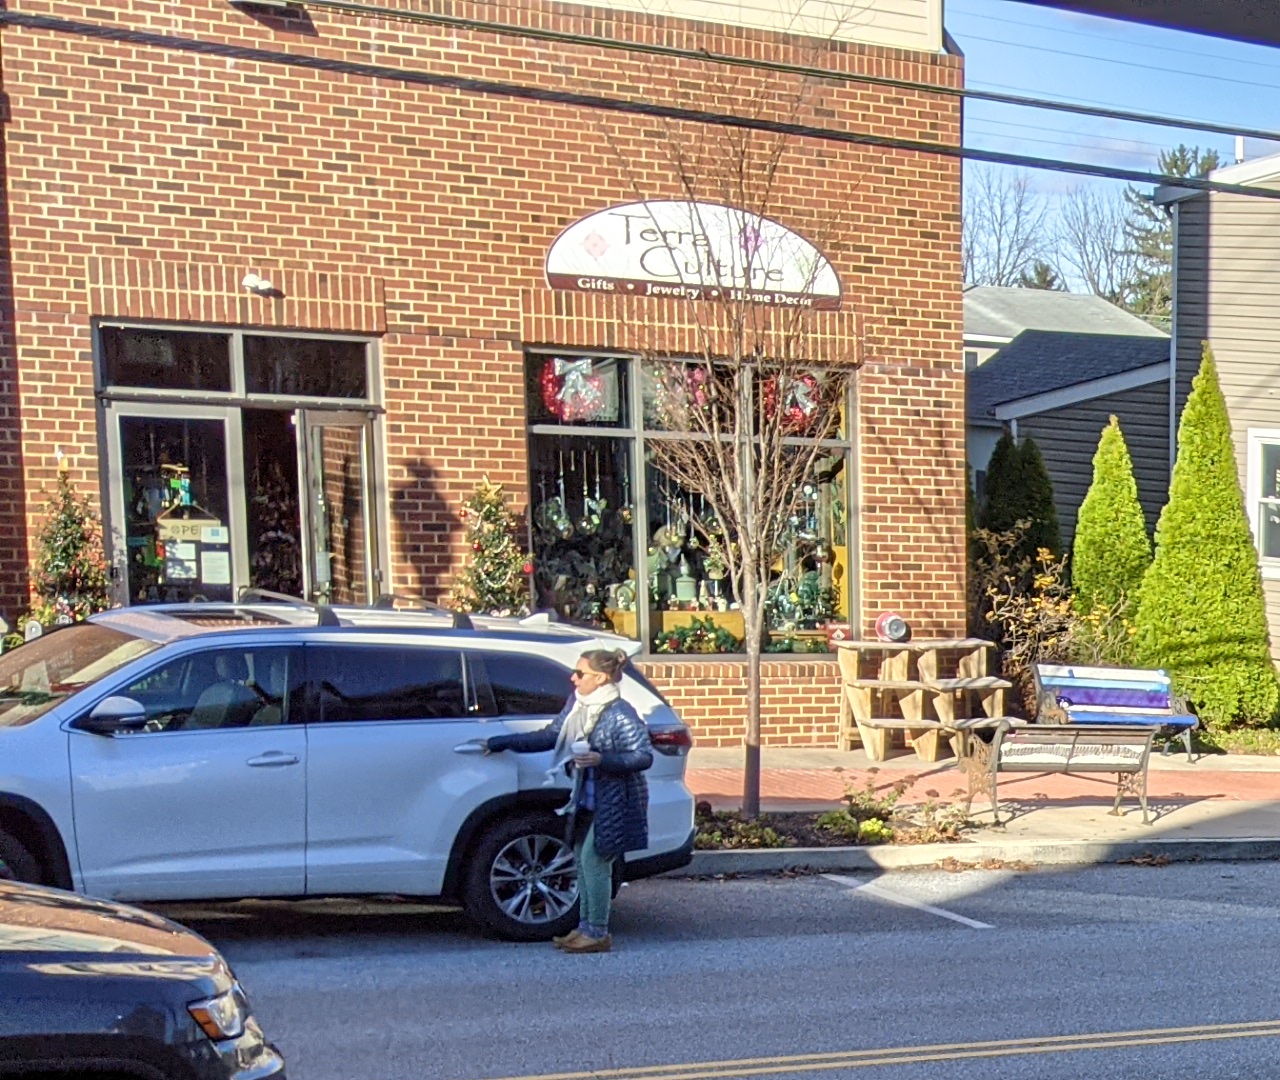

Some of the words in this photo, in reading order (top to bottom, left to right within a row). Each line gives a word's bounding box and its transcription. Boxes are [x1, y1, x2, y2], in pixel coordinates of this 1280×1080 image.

[608, 212, 708, 246] Terra
[639, 246, 784, 281] Culture
[577, 277, 615, 291] Gifts
[646, 283, 700, 300] Jewelry
[730, 290, 771, 304] Home
[171, 525, 200, 536] OPE
